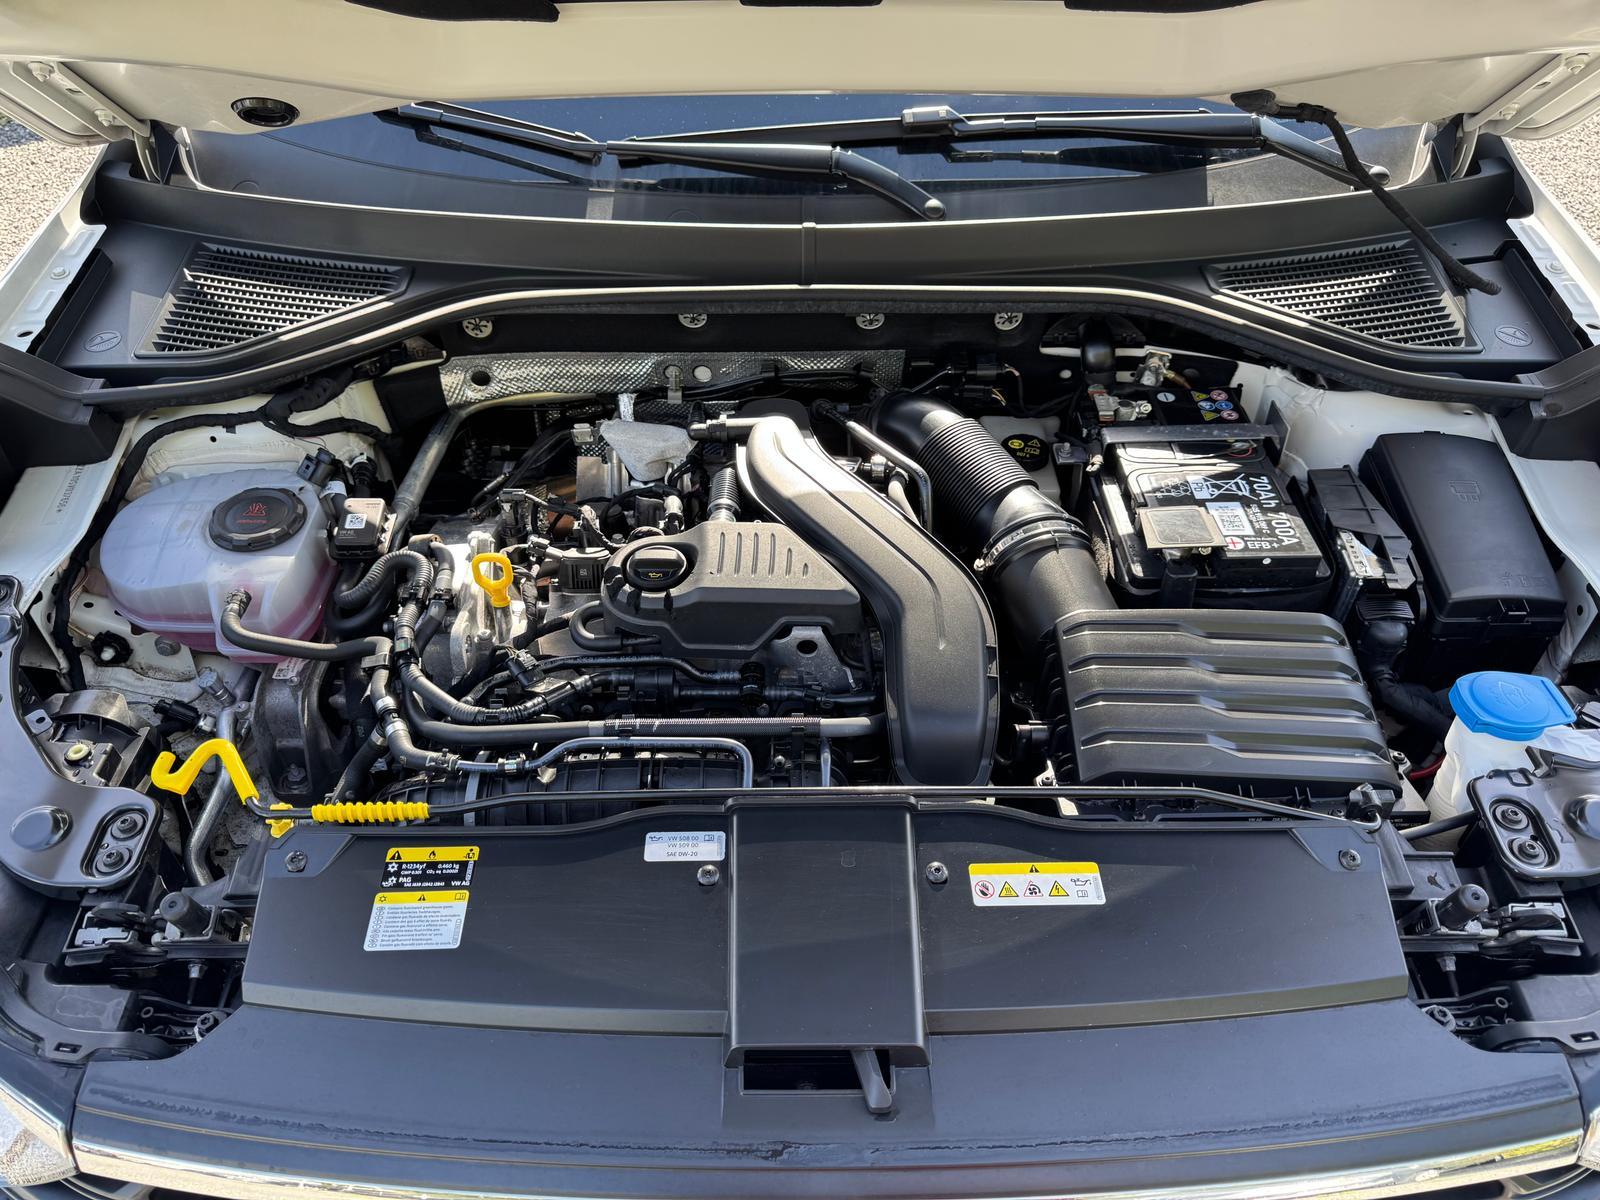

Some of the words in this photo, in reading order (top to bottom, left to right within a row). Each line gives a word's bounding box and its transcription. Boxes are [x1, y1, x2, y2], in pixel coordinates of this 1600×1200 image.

[1249, 476, 1280, 508] 70Ah
[1267, 511, 1300, 546] 700A
[1246, 541, 1271, 549] EFB
